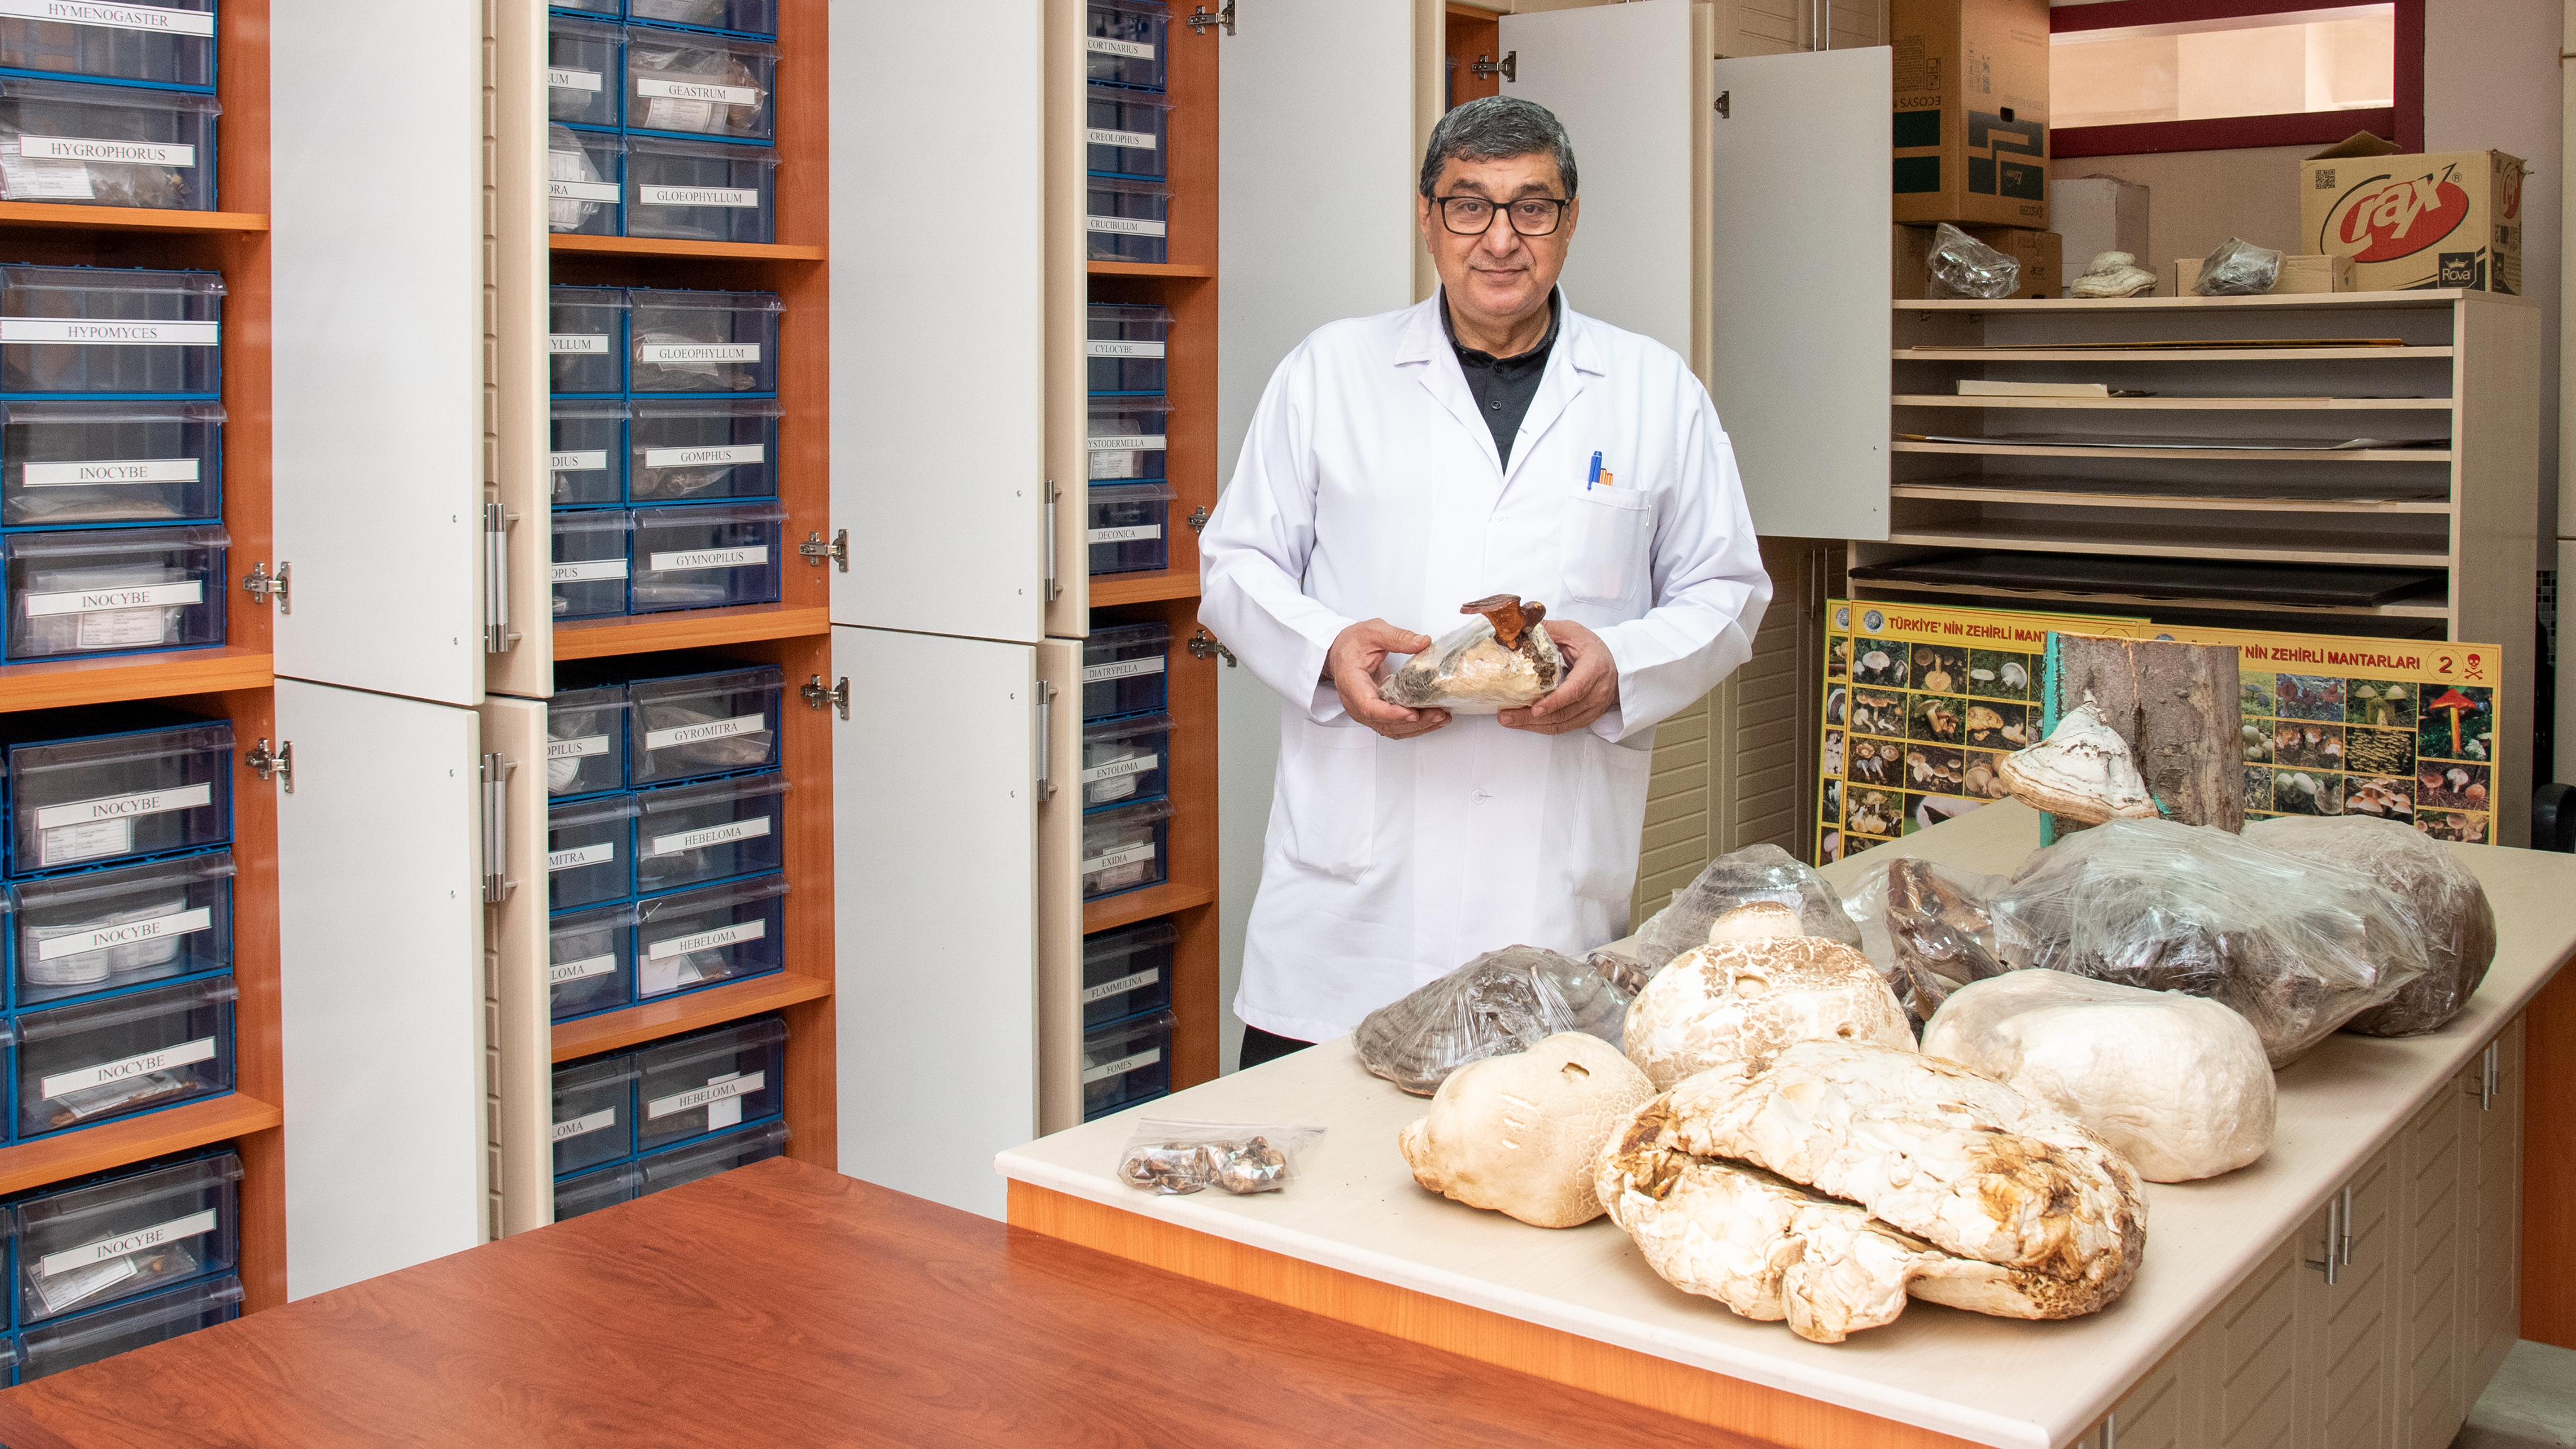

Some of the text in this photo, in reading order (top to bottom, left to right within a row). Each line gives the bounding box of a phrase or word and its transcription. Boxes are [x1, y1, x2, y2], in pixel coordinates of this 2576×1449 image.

[48, 4, 169, 27] HYMENOGASTER
[1088, 40, 1138, 55] CORTINARIUS
[549, 74, 569, 84] UM
[669, 86, 726, 99] GEASTRUM
[1901, 96, 1941, 109] ECOSYS
[1091, 131, 1140, 145] CREOLOPHUS
[51, 143, 166, 162] HYGROPHORUS
[657, 191, 742, 203] GLOEOPHYLLUM
[1091, 219, 1138, 231] CRUCIBULUM
[2442, 268, 2470, 280] Rova
[68, 326, 157, 339] HYPOMYCES
[550, 339, 591, 350] YLLUM
[1095, 345, 1133, 353] CYLOCYBE
[659, 348, 745, 359] GLOEOPHYLLUM
[1088, 439, 1145, 448] YSTODERMELLA
[552, 456, 579, 467] DIUS
[680, 450, 732, 463] GOMPHUS
[80, 466, 148, 479] INOCYBE
[1097, 529, 1136, 540] DECONICA
[676, 552, 744, 566] GYMNOPILUS
[552, 567, 578, 579] OPUS
[82, 591, 150, 608] INOCYBE
[1943, 620, 1963, 636] NİN
[1966, 623, 2011, 640] ZEHİRLİ
[2245, 643, 2267, 660] NİN
[2271, 646, 2324, 664] ZEHİRLİ
[2328, 651, 2421, 670] MANTARLARI
[2439, 656, 2453, 674] 2
[1089, 664, 1138, 679] DIATRYPELLA
[675, 721, 738, 741] GYROMITRA
[1097, 762, 1138, 779] ENTOLOMA
[93, 796, 160, 817] INOCYBE
[684, 826, 742, 847] HEBELOMA
[549, 852, 585, 867] MITRA
[1102, 854, 1128, 868] EXIDIA
[94, 922, 161, 946] INOCYBE
[680, 930, 736, 952] HEBELOMA
[550, 965, 584, 980] LOMA
[1091, 976, 1143, 999] FLAMMULINA
[98, 1054, 165, 1082] INOCYBE
[1107, 1060, 1132, 1075] FOMES
[679, 1084, 736, 1108] HEBELOMA
[97, 1228, 164, 1258] INOCYBE
